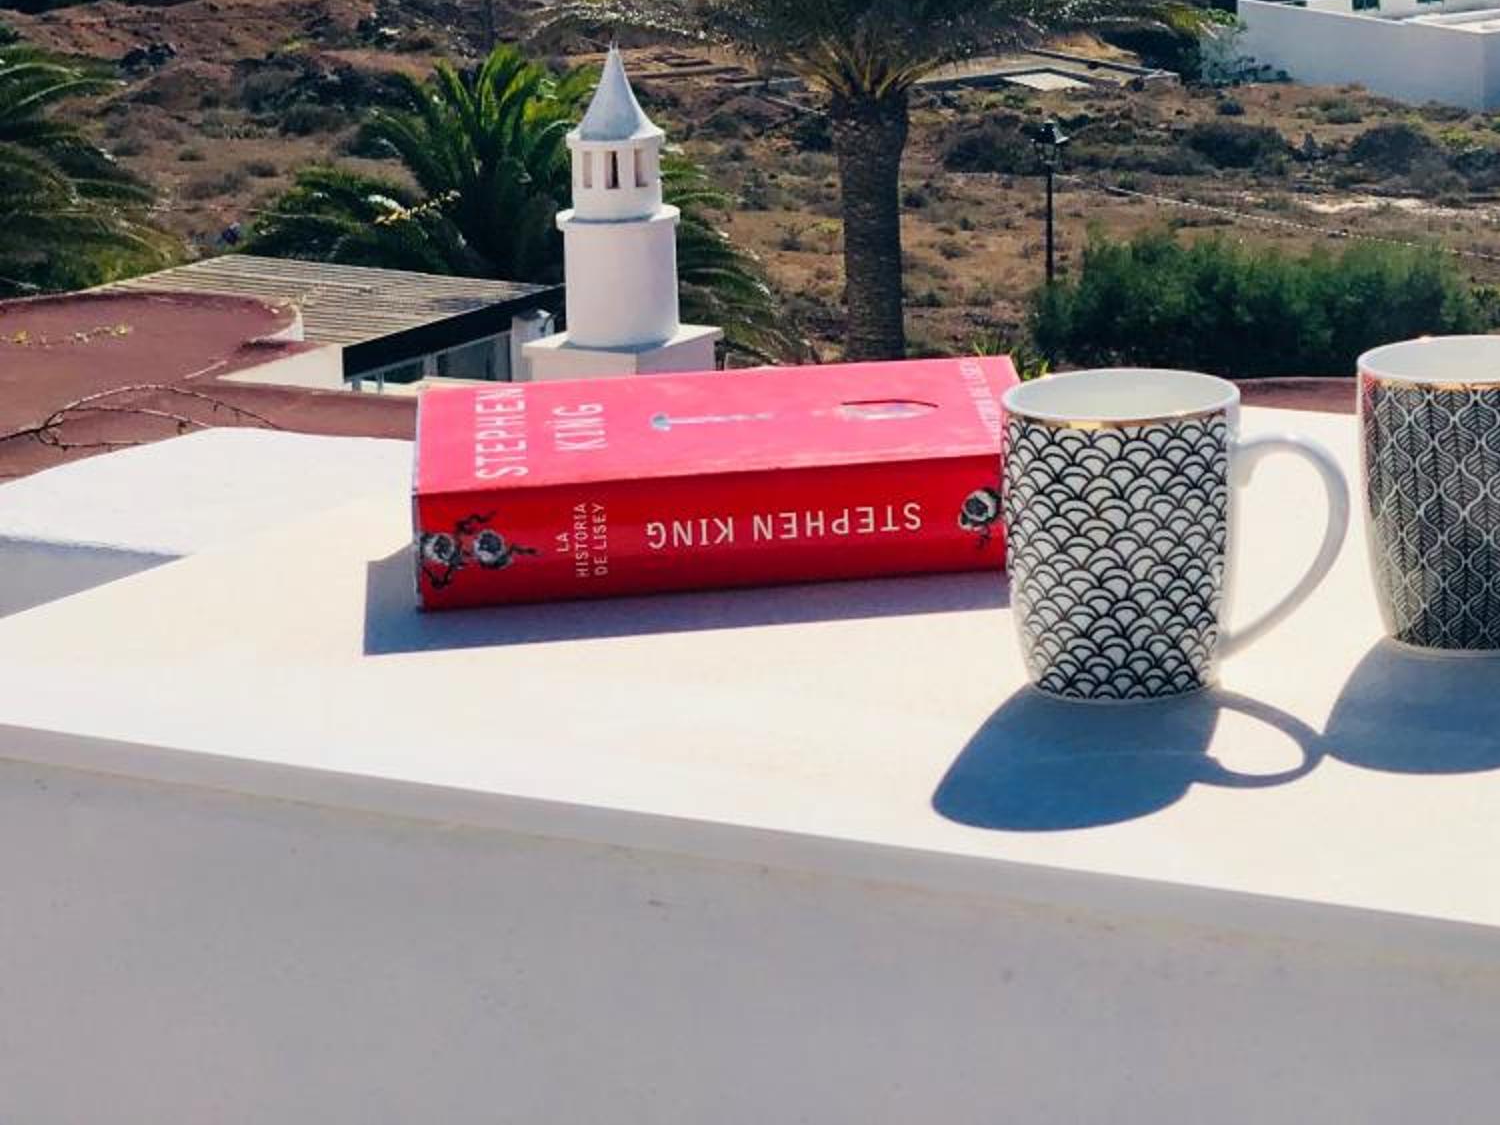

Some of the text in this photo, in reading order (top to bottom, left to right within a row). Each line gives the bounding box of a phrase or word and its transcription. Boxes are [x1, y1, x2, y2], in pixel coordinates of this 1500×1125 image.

[475, 386, 528, 479] STEPHEN
[553, 404, 606, 451] KING
[555, 532, 569, 552] LA
[574, 503, 589, 577] HISTORIA
[592, 502, 608, 576] DE LISEY
[645, 502, 921, 550] STEPHEN KING
